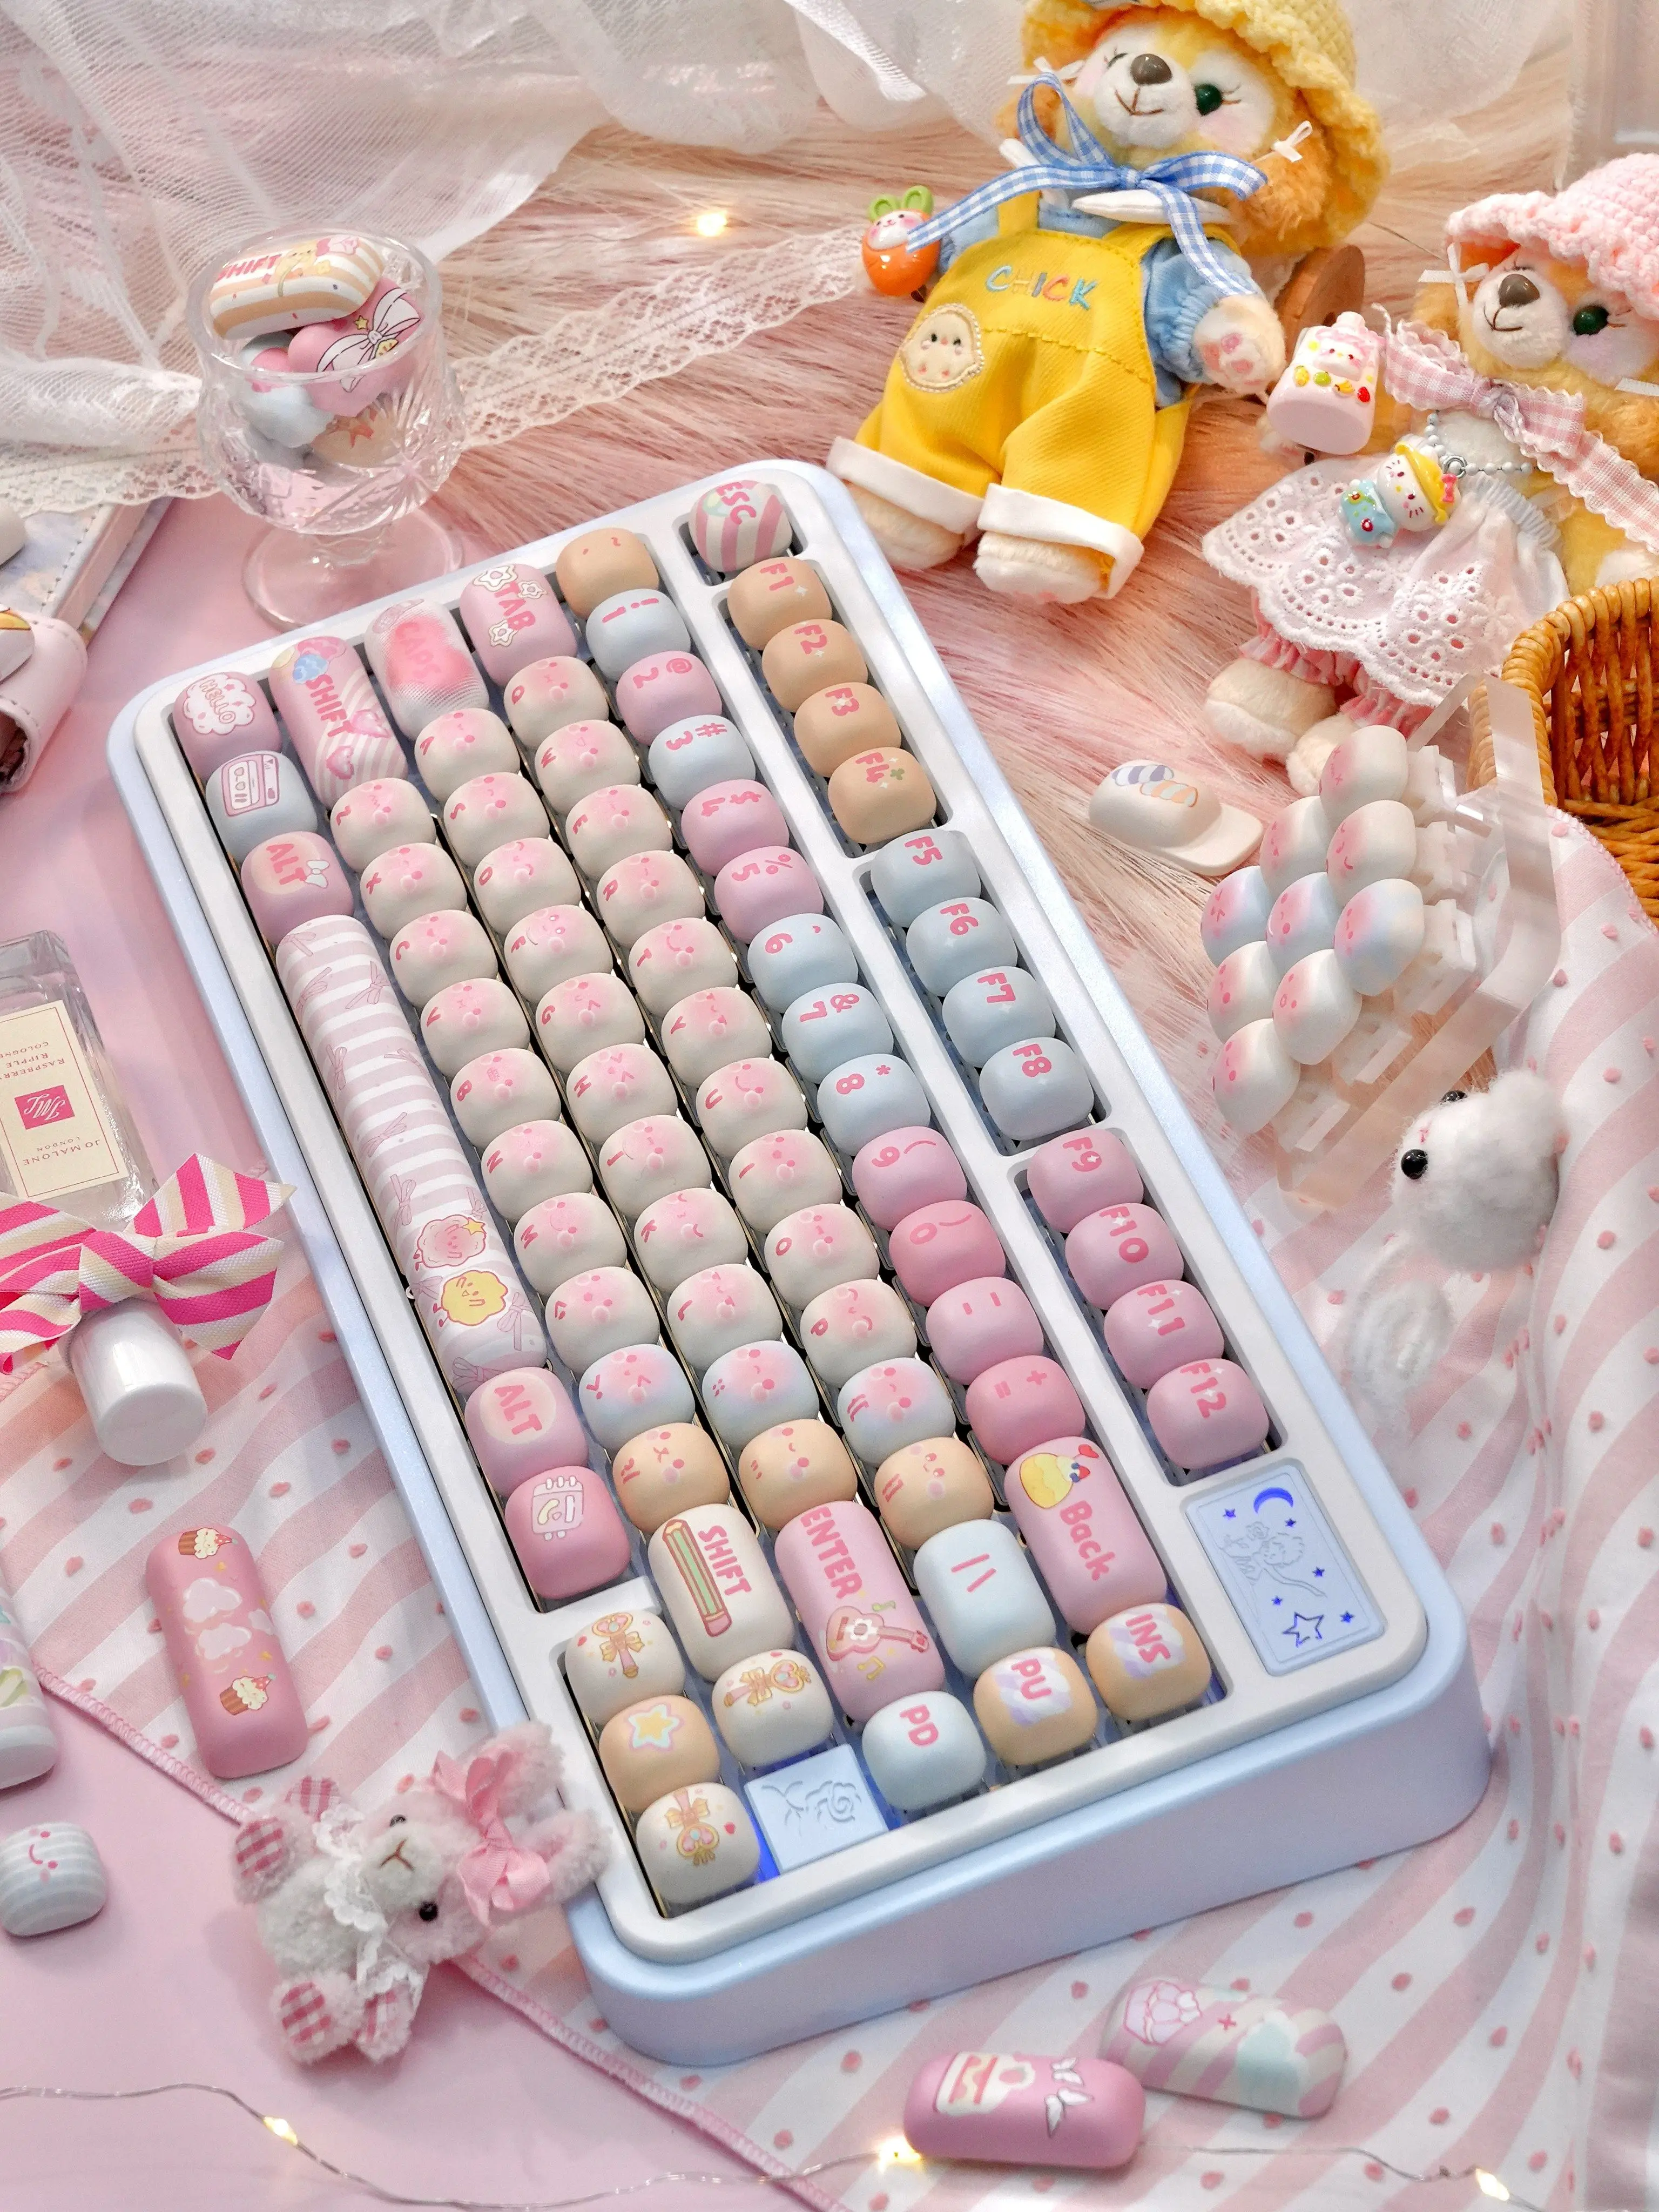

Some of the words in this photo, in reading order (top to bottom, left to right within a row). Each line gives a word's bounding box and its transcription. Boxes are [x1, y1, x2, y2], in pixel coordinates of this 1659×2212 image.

[985, 265, 1098, 311] CHICK
[716, 482, 757, 525] ESC
[760, 563, 794, 591] F1
[495, 581, 536, 631] TAB
[794, 624, 827, 655] F2
[633, 667, 659, 689] 2
[199, 677, 236, 724] HELLO
[306, 674, 354, 737] SHIFT
[826, 687, 859, 716] F3
[665, 731, 692, 751] 3
[541, 748, 554, 767] W
[855, 752, 889, 783] F4
[335, 805, 352, 825] Z
[449, 803, 466, 819] S
[702, 797, 725, 817] 4
[572, 814, 588, 834] E
[904, 837, 942, 865] F5
[267, 844, 306, 884] ALT
[732, 863, 758, 881] 5
[365, 873, 381, 894] X
[603, 879, 618, 900] R
[940, 903, 978, 935] F6
[395, 940, 410, 962] C
[511, 936, 525, 951] F
[765, 933, 792, 954] 6
[637, 948, 652, 967] T
[977, 973, 1015, 1002] F7
[426, 1007, 441, 1026] V
[541, 1005, 556, 1026] G
[799, 1001, 827, 1022] 7
[670, 1016, 686, 1034] Y
[0, 1058, 65, 1079] RASPBERR
[6, 1053, 49, 1068] RIPPLE
[1013, 1044, 1051, 1077] F8
[456, 1080, 472, 1101] B
[574, 1076, 592, 1097] H
[836, 1074, 864, 1094] 8
[705, 1089, 723, 1109] U
[37, 1137, 80, 1151] LONDON
[85, 1139, 101, 1148] JO
[1063, 1137, 1102, 1172] F9
[23, 1144, 80, 1166] MALONE
[487, 1150, 502, 1172] N
[872, 1147, 900, 1168] 9
[521, 1224, 539, 1248] M
[640, 1219, 657, 1242] K
[1100, 1206, 1149, 1264] F10
[1137, 1284, 1185, 1336] F11
[811, 1319, 828, 1337] P
[1180, 1362, 1226, 1419] F12
[494, 1385, 542, 1434] ALT
[1060, 1501, 1115, 1581] Back
[698, 1526, 751, 1596] SHIFT
[801, 1507, 862, 1599] ENTER
[1127, 1614, 1170, 1663] INS
[1011, 1659, 1052, 1700] PU
[900, 1705, 939, 1746] PD
